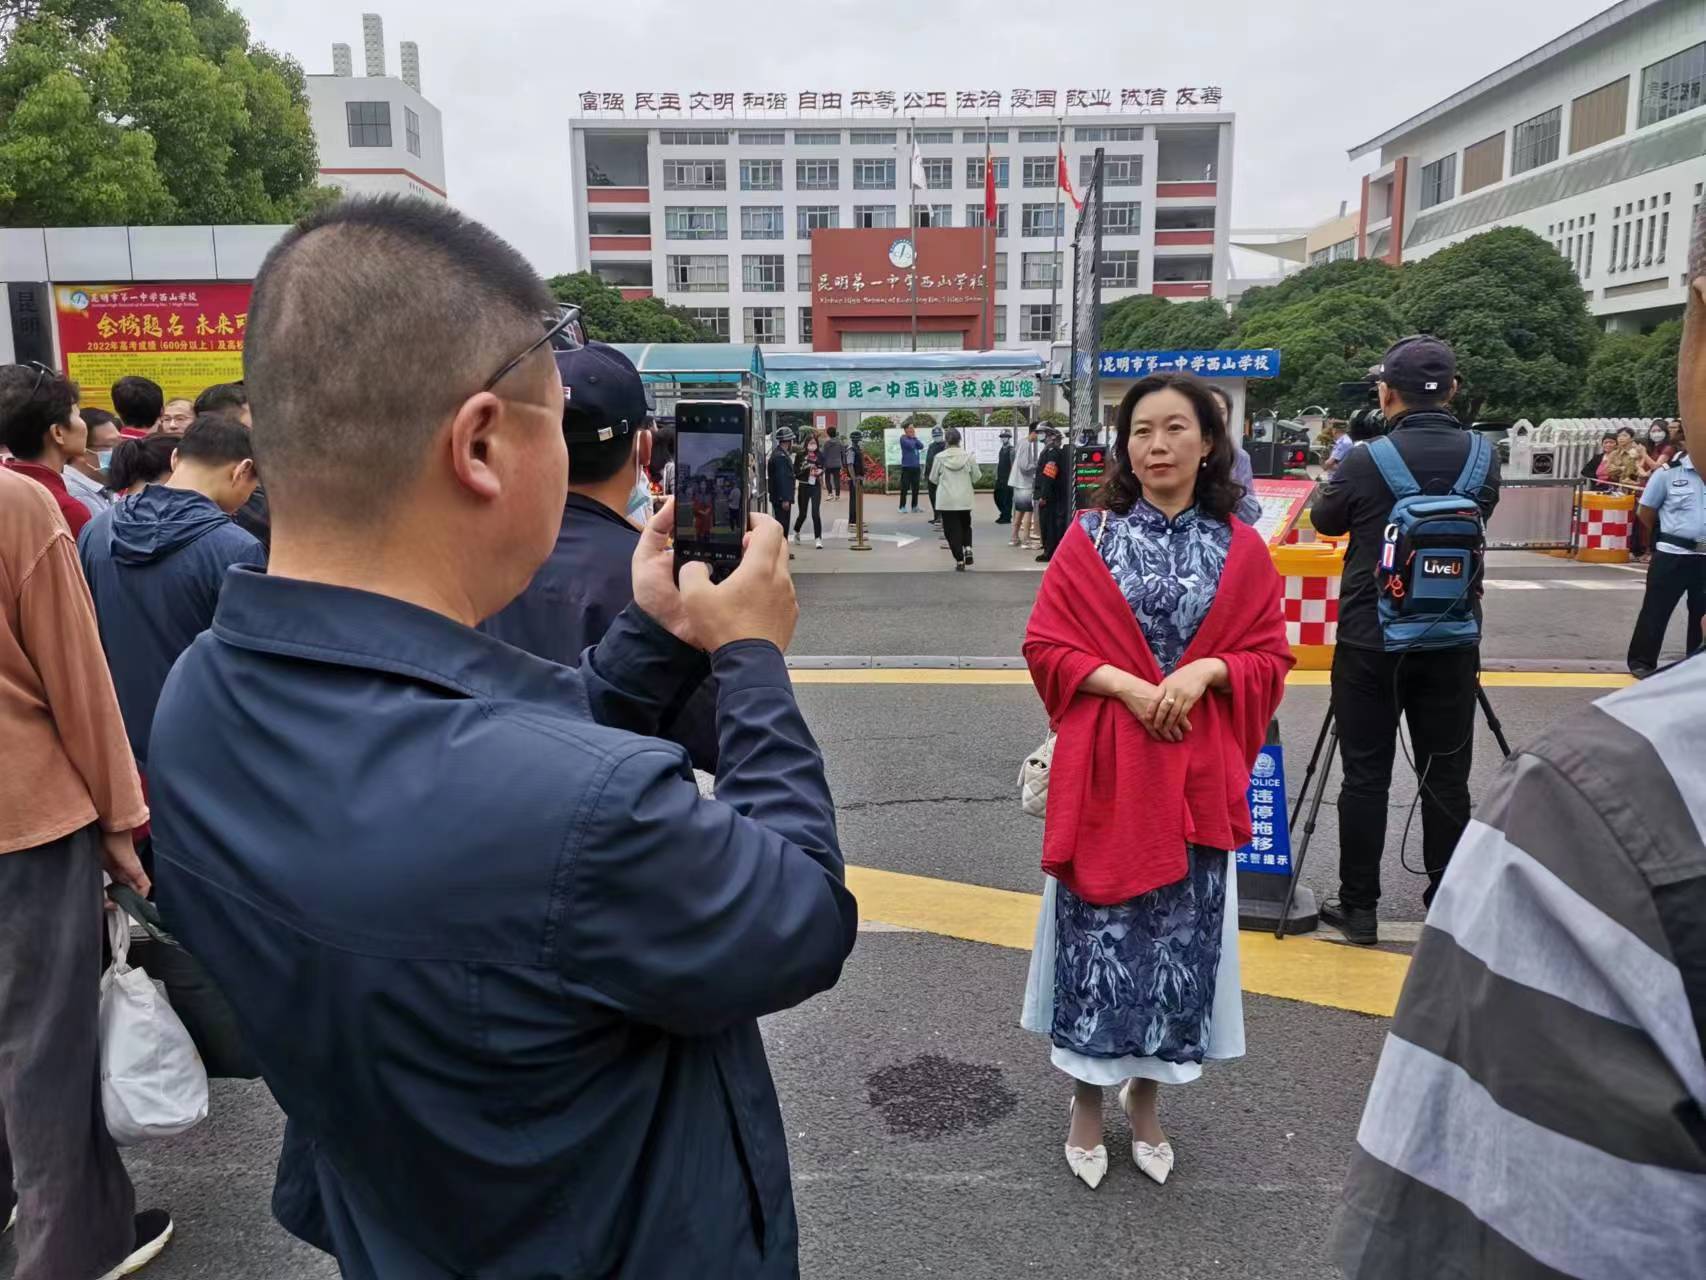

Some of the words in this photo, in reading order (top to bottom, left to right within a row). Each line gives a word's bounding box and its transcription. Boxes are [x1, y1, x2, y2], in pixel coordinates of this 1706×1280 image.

[579, 91, 624, 110] 富强
[635, 91, 681, 110] 民主
[689, 91, 734, 110] 文明
[743, 91, 787, 110] 和谐
[799, 91, 842, 110] 自由
[850, 91, 896, 110] 平等
[904, 91, 947, 109] 公正
[956, 89, 1000, 108] 法治
[1011, 89, 1057, 108] 爱国
[1066, 88, 1111, 107] 敬业
[1120, 88, 1168, 107] 诚信
[1176, 86, 1223, 106] 友善
[1103, 355, 1270, 372] 昆明市第一中学西山学校
[1424, 560, 1461, 575] LiveU
[1249, 778, 1281, 787] OLICE
[1252, 789, 1273, 851] 违停拖移
